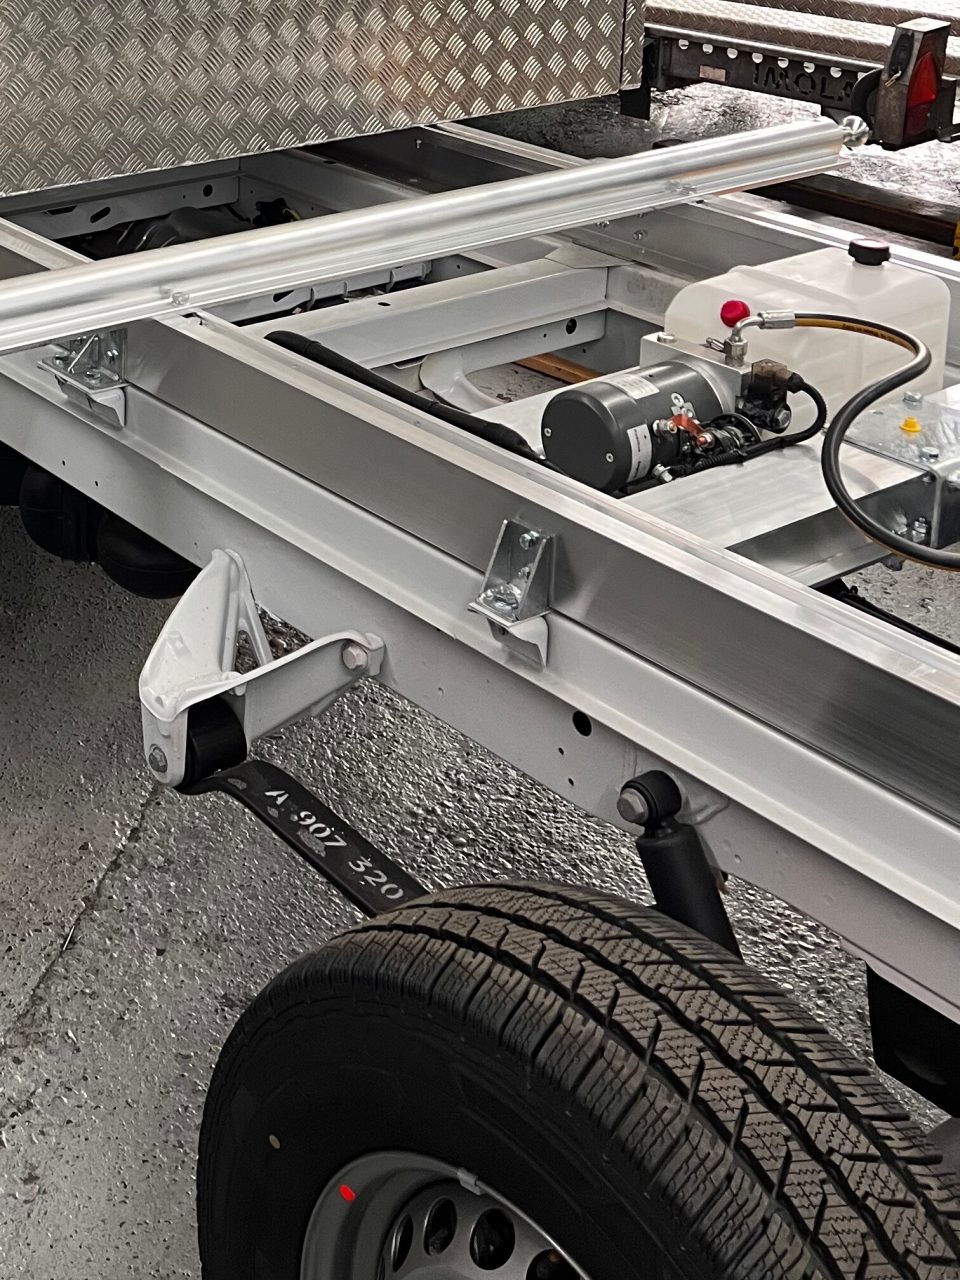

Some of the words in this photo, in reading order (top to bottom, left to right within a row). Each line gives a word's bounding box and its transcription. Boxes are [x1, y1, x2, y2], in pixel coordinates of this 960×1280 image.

[264, 790, 289, 805] A
[298, 810, 348, 847] 907
[348, 855, 404, 900] 320
